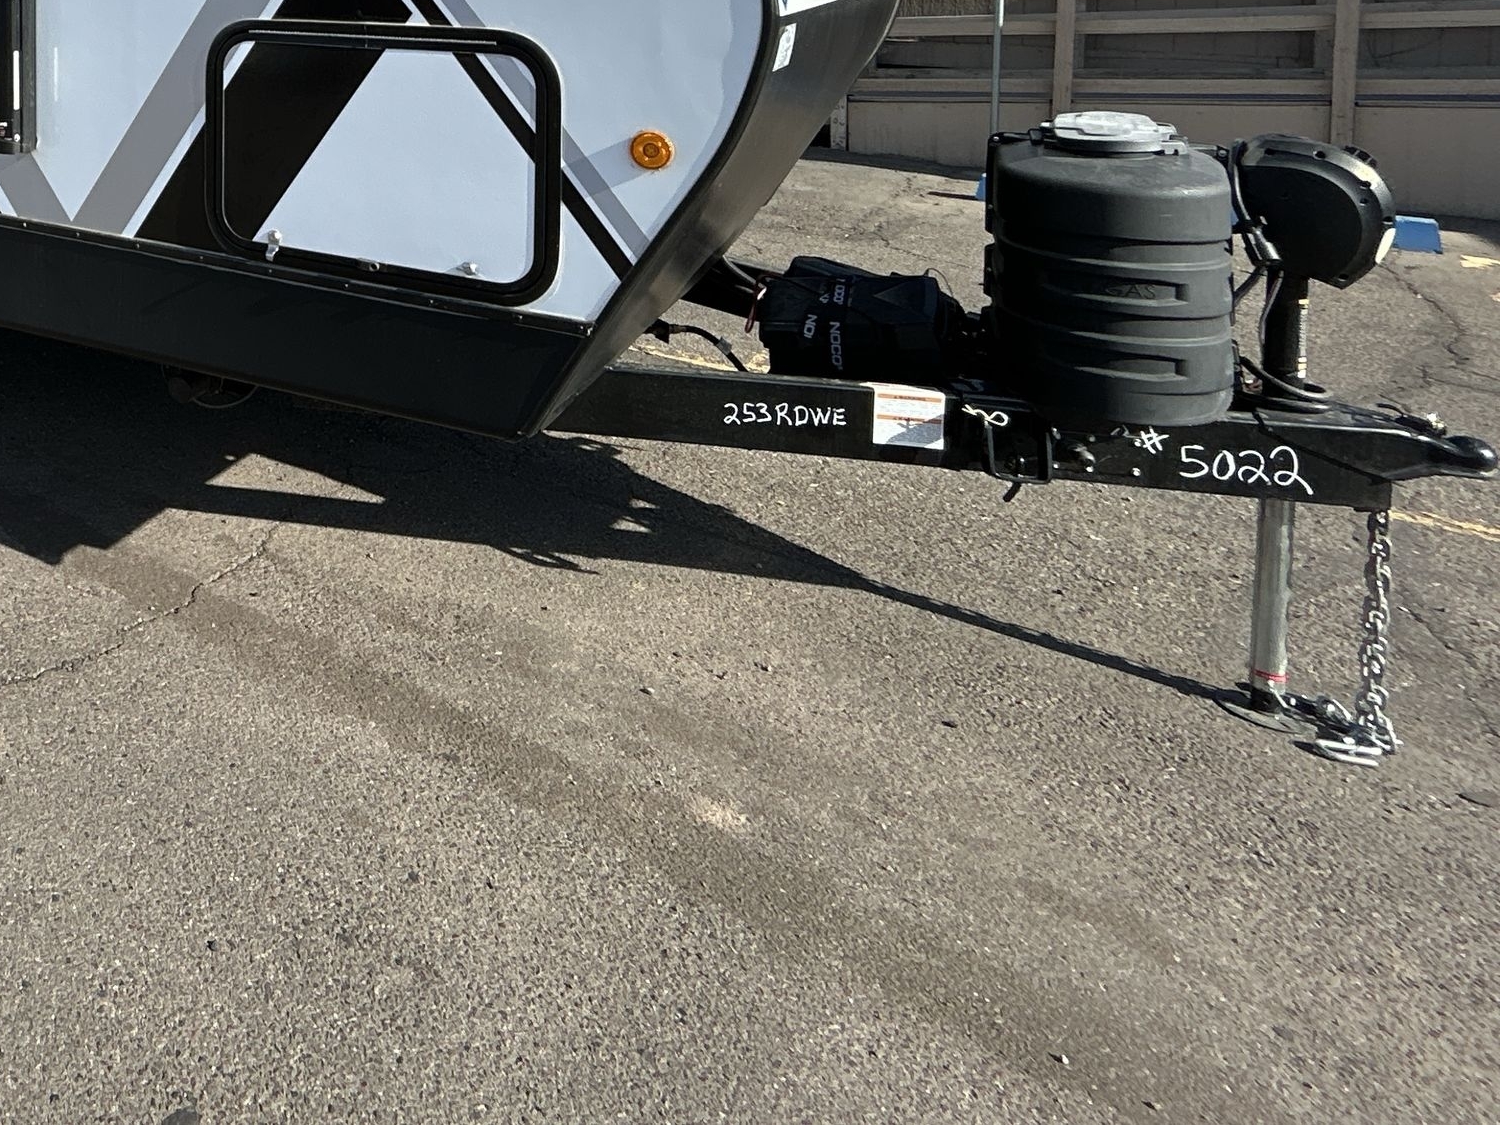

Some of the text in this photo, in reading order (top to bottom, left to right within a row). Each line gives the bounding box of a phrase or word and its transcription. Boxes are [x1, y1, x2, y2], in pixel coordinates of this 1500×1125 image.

[1106, 283, 1156, 299] GAS
[829, 321, 843, 367] NOCO
[723, 402, 847, 426] 253RDWE
[1179, 444, 1315, 496] 5022
